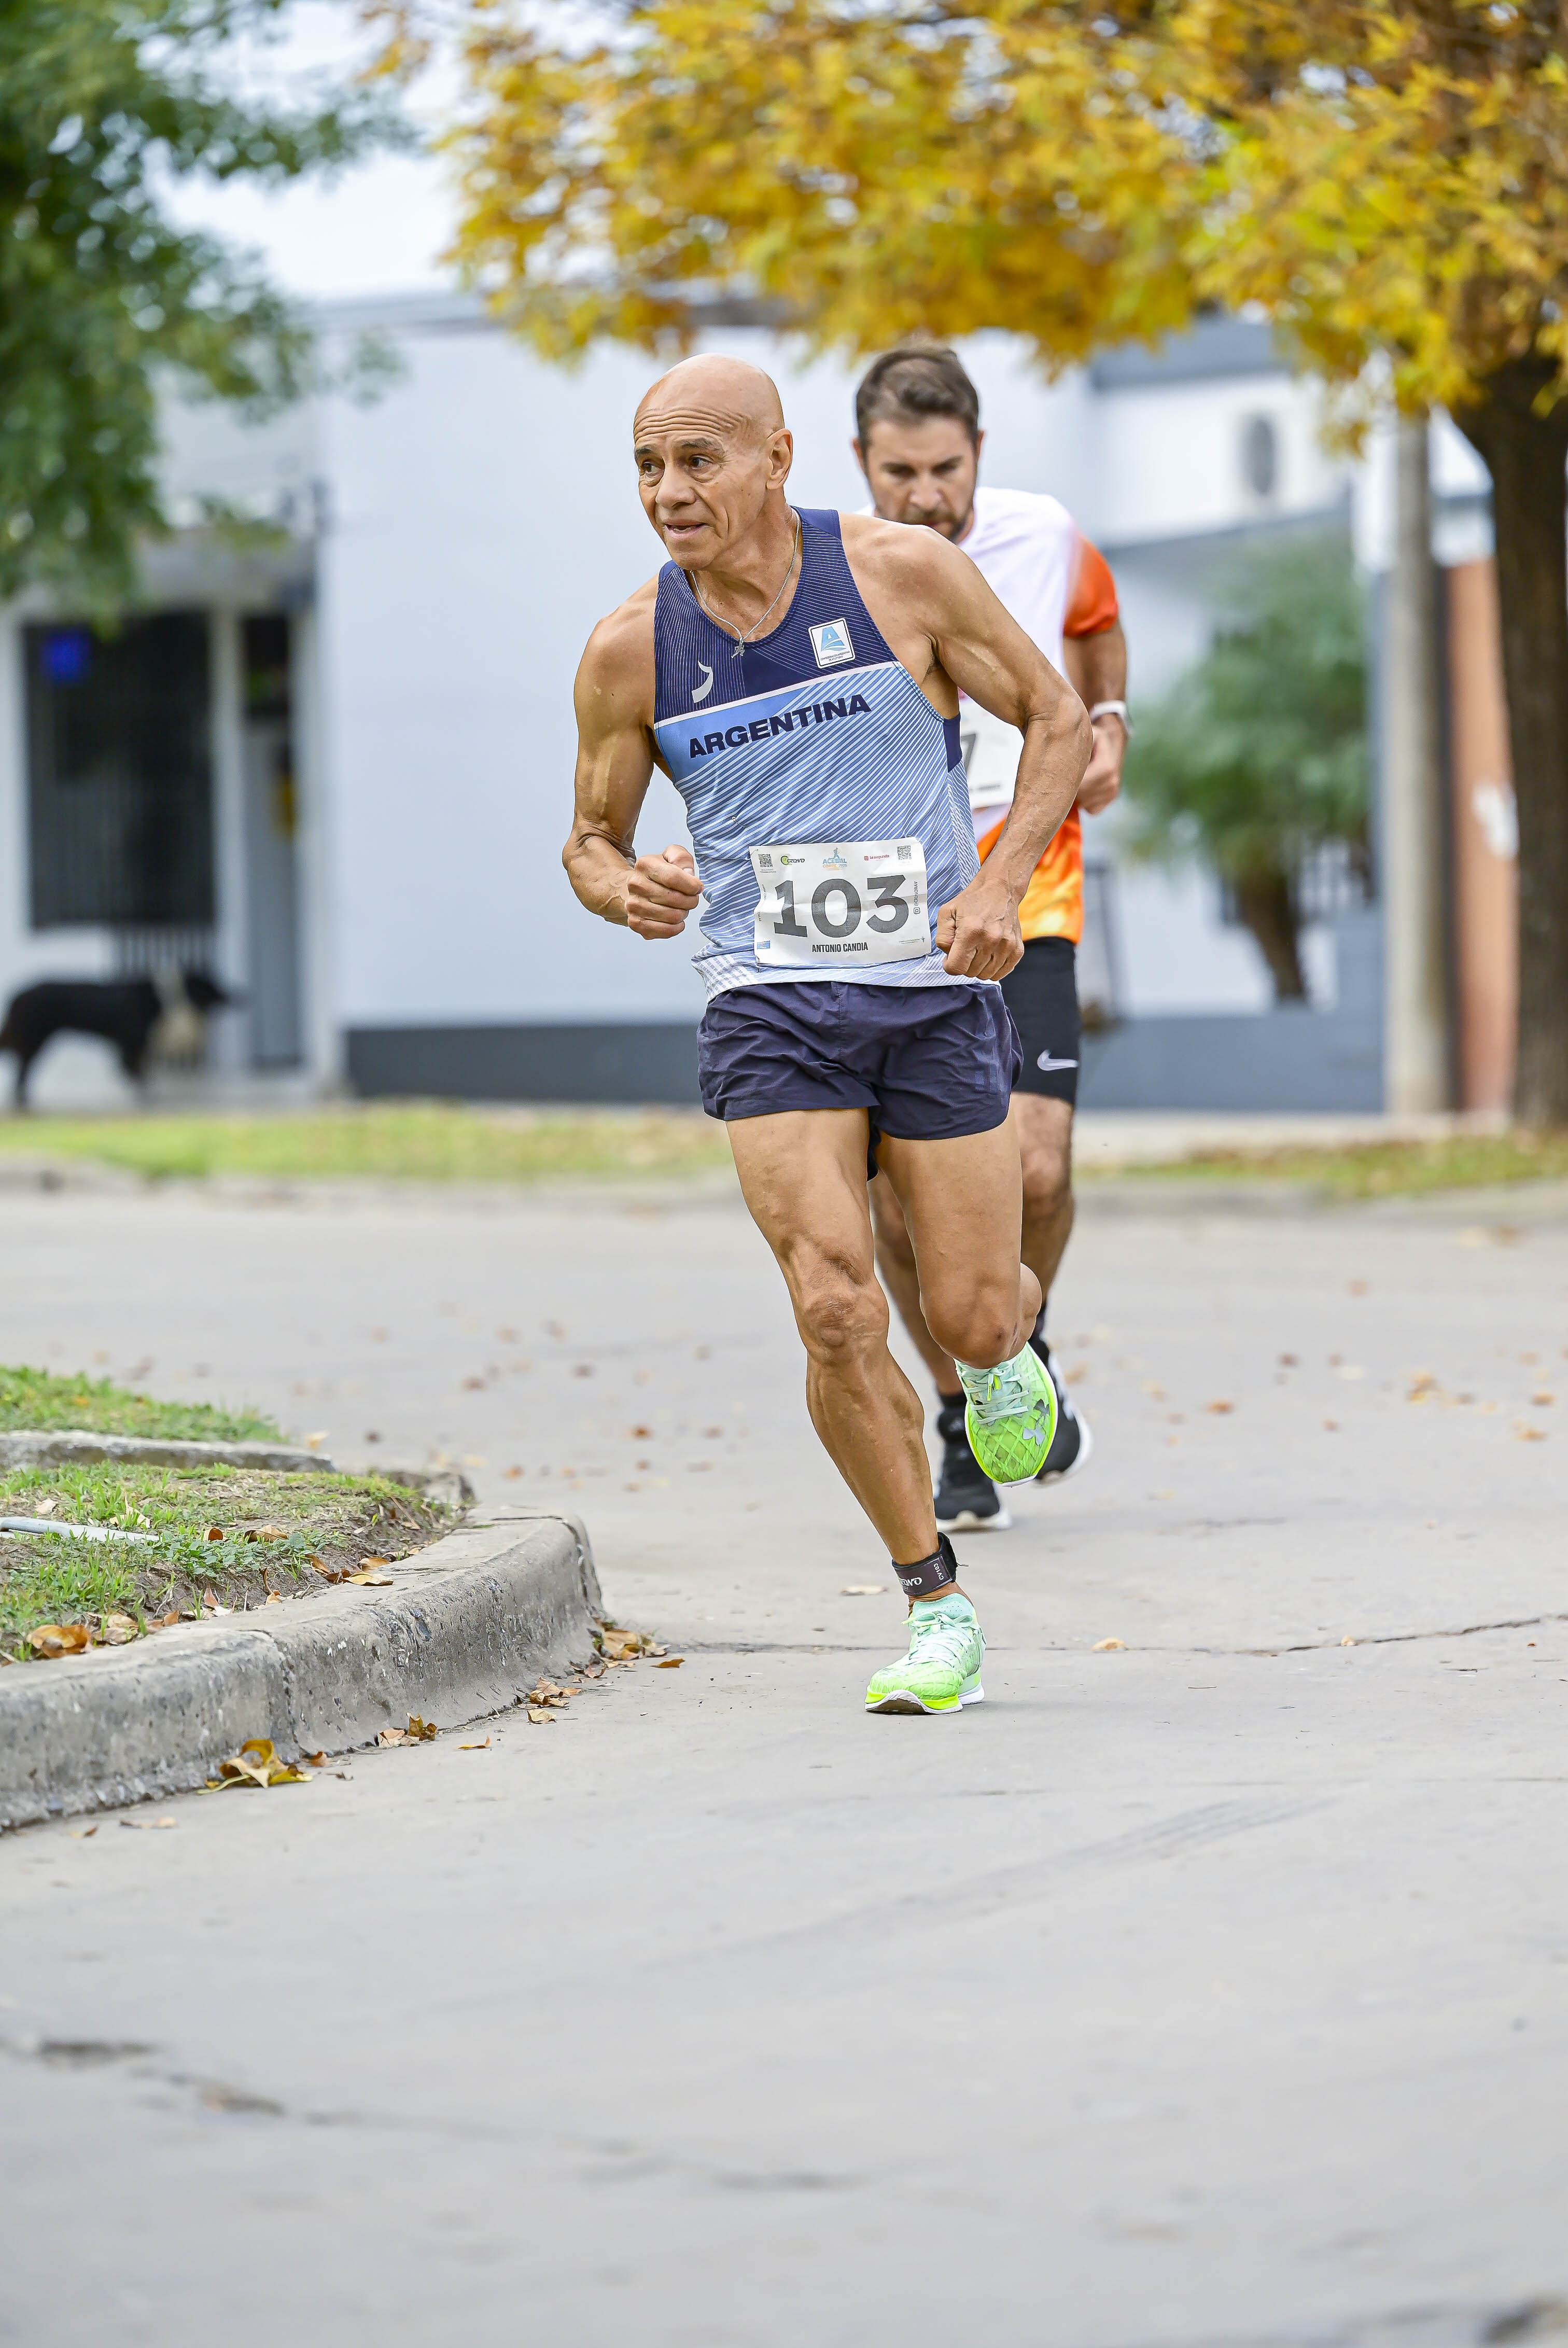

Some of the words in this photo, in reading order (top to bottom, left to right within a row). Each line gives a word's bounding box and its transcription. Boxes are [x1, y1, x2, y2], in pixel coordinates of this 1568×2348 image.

[690, 694, 872, 758] ARGENTINA
[774, 875, 908, 938] 103
[812, 944, 841, 952] ANTONIO
[843, 942, 868, 952] CANDIA
[933, 1563, 944, 1580] CV103
